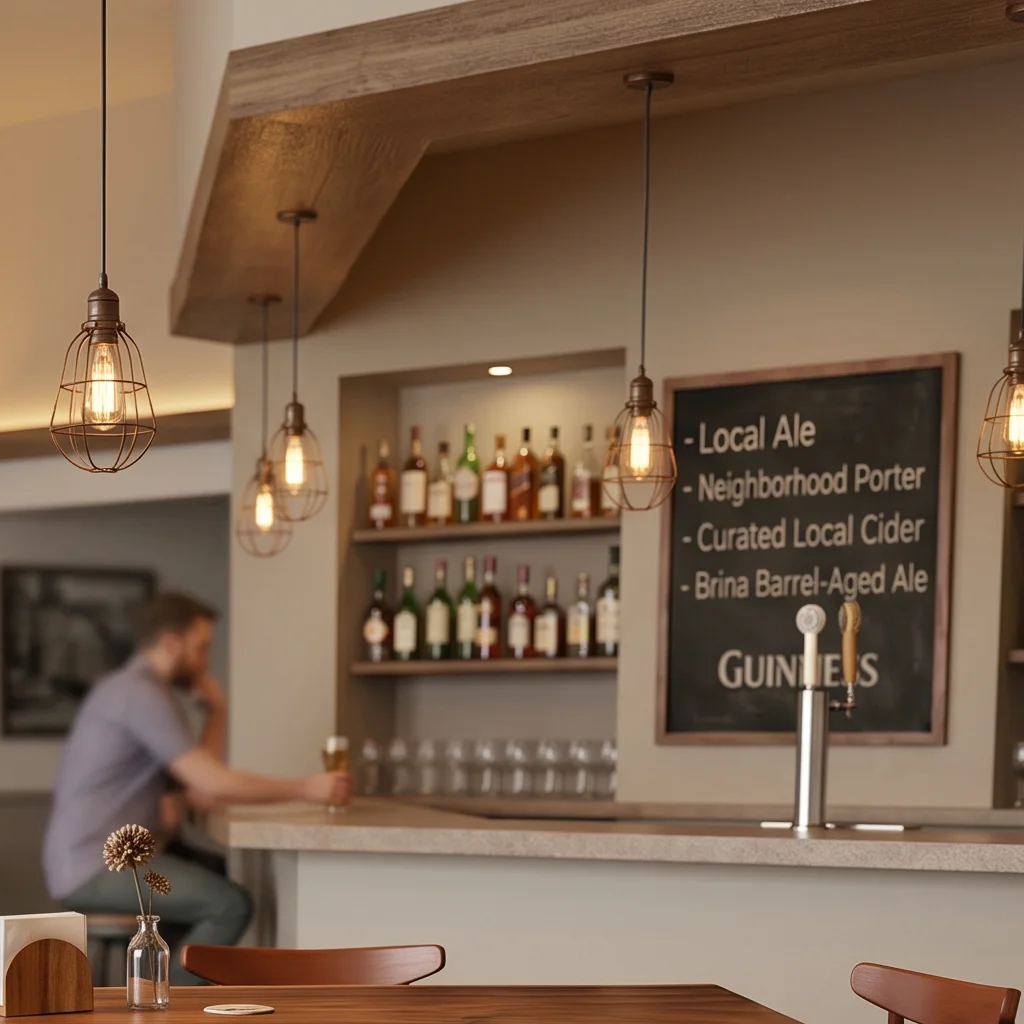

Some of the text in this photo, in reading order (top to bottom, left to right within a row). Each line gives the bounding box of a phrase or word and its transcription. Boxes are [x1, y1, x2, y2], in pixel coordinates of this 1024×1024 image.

[699, 416, 765, 454] Local
[772, 413, 816, 448] Ale
[698, 464, 847, 506] Neighborhood
[855, 463, 926, 493] Porter
[697, 518, 786, 551] Curated
[794, 514, 854, 548] Local
[860, 512, 925, 544] Cider
[695, 570, 748, 599] Brina
[755, 564, 886, 600] Barrel-Aged
[891, 563, 928, 593] Ale
[718, 649, 879, 689] GUINES
